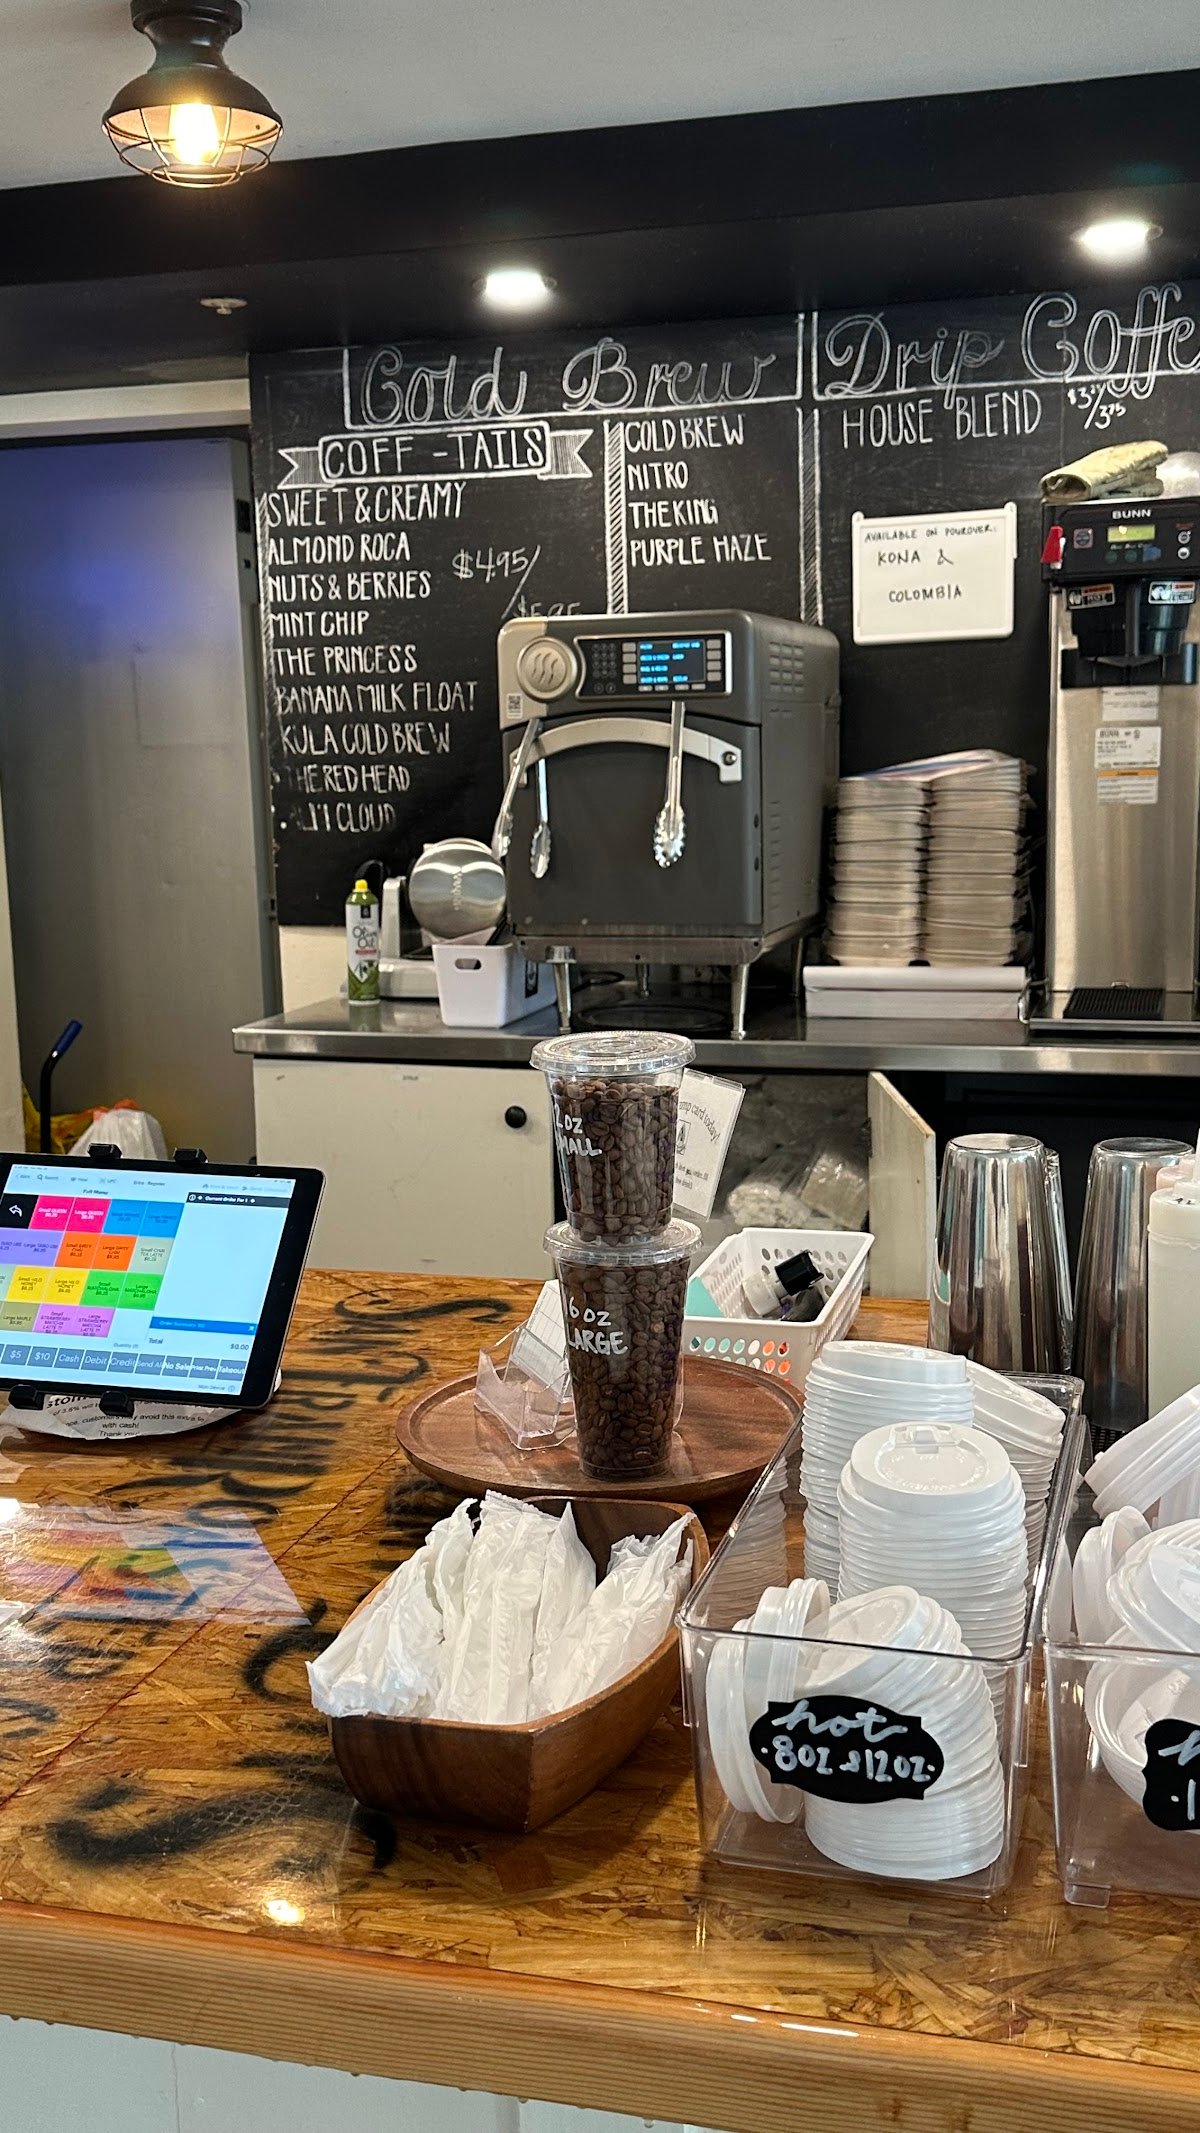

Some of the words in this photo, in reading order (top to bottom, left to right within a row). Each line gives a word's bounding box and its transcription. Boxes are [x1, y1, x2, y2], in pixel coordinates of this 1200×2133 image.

[824, 311, 1004, 409] Drip
[1021, 283, 1200, 400] Coffe
[361, 345, 527, 427] Cold
[563, 337, 776, 412] Brew
[625, 418, 677, 452] COLD
[680, 414, 745, 449] BREW
[843, 399, 933, 449] HOUSE
[955, 389, 1042, 440] BLEND
[323, 434, 413, 478] COFF
[627, 461, 689, 491] NITRO
[268, 488, 348, 528] SWEET
[355, 486, 371, 524] &
[375, 481, 466, 522] CREAMY
[628, 500, 672, 529] THE
[673, 498, 719, 527] KING
[1112, 509, 1152, 519] BUNN
[268, 535, 354, 566] ALMOND
[360, 531, 411, 562] ROCA
[865, 529, 917, 543] AVAILABLE
[926, 527, 938, 537] ON
[630, 536, 705, 567] PURPLE
[712, 533, 772, 562] HAZE
[877, 550, 921, 566] KONA
[268, 574, 324, 602] NUTS
[328, 573, 341, 599] &
[348, 570, 432, 600] BERRIES
[888, 584, 962, 603] COLOMBIA
[270, 611, 316, 638] MINT
[320, 610, 370, 637] CHIP
[274, 647, 316, 676] THE
[323, 644, 418, 675] PRINCESS
[276, 685, 352, 716] BANANA
[357, 683, 407, 712] MILK
[413, 681, 477, 712] FLOAT
[281, 722, 339, 757] KULA
[342, 722, 389, 755] COLD
[392, 722, 450, 755] BREW
[323, 764, 358, 793] RED
[361, 764, 411, 793] HEAD
[336, 803, 396, 833] CLOUD
[691, 1105, 706, 1121] card
[557, 1137, 602, 1157] MALL
[568, 1296, 580, 1319] 6
[10, 1350, 22, 1359] $5
[230, 1343, 249, 1351] $0.00
[568, 1327, 628, 1355] LARGE
[34, 1352, 50, 1361] $10
[58, 1354, 80, 1362] Cash
[85, 1355, 108, 1365] Debit
[111, 1357, 136, 1367] Credit
[164, 1362, 174, 1370] No
[175, 1362, 191, 1370] Sale
[771, 1699, 908, 1743] hot
